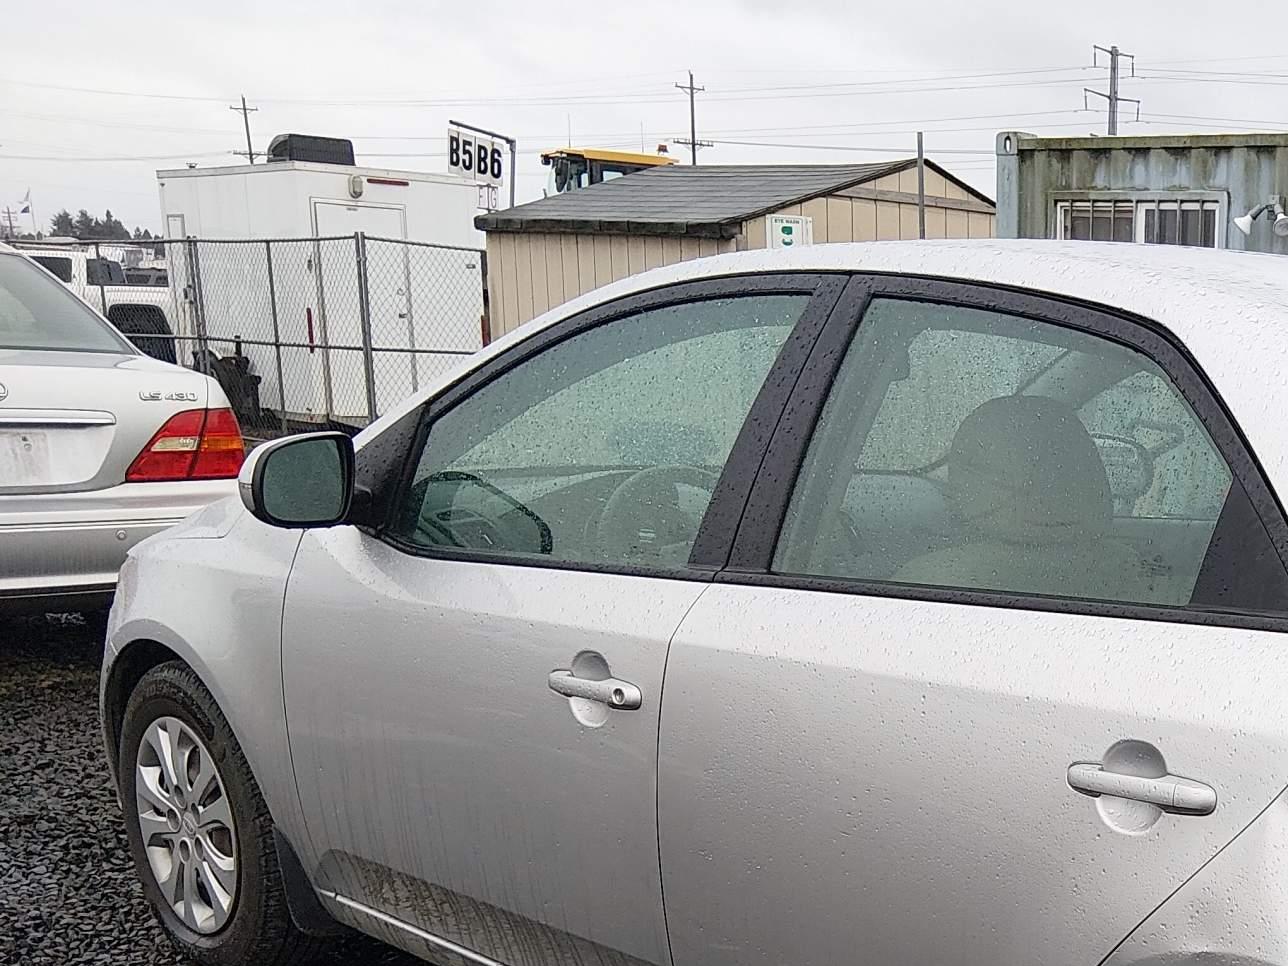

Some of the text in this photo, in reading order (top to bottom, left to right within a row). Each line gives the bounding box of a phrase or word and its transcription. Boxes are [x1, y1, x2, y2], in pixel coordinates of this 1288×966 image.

[449, 135, 502, 179] B5 B6
[138, 391, 198, 402] LS 430
